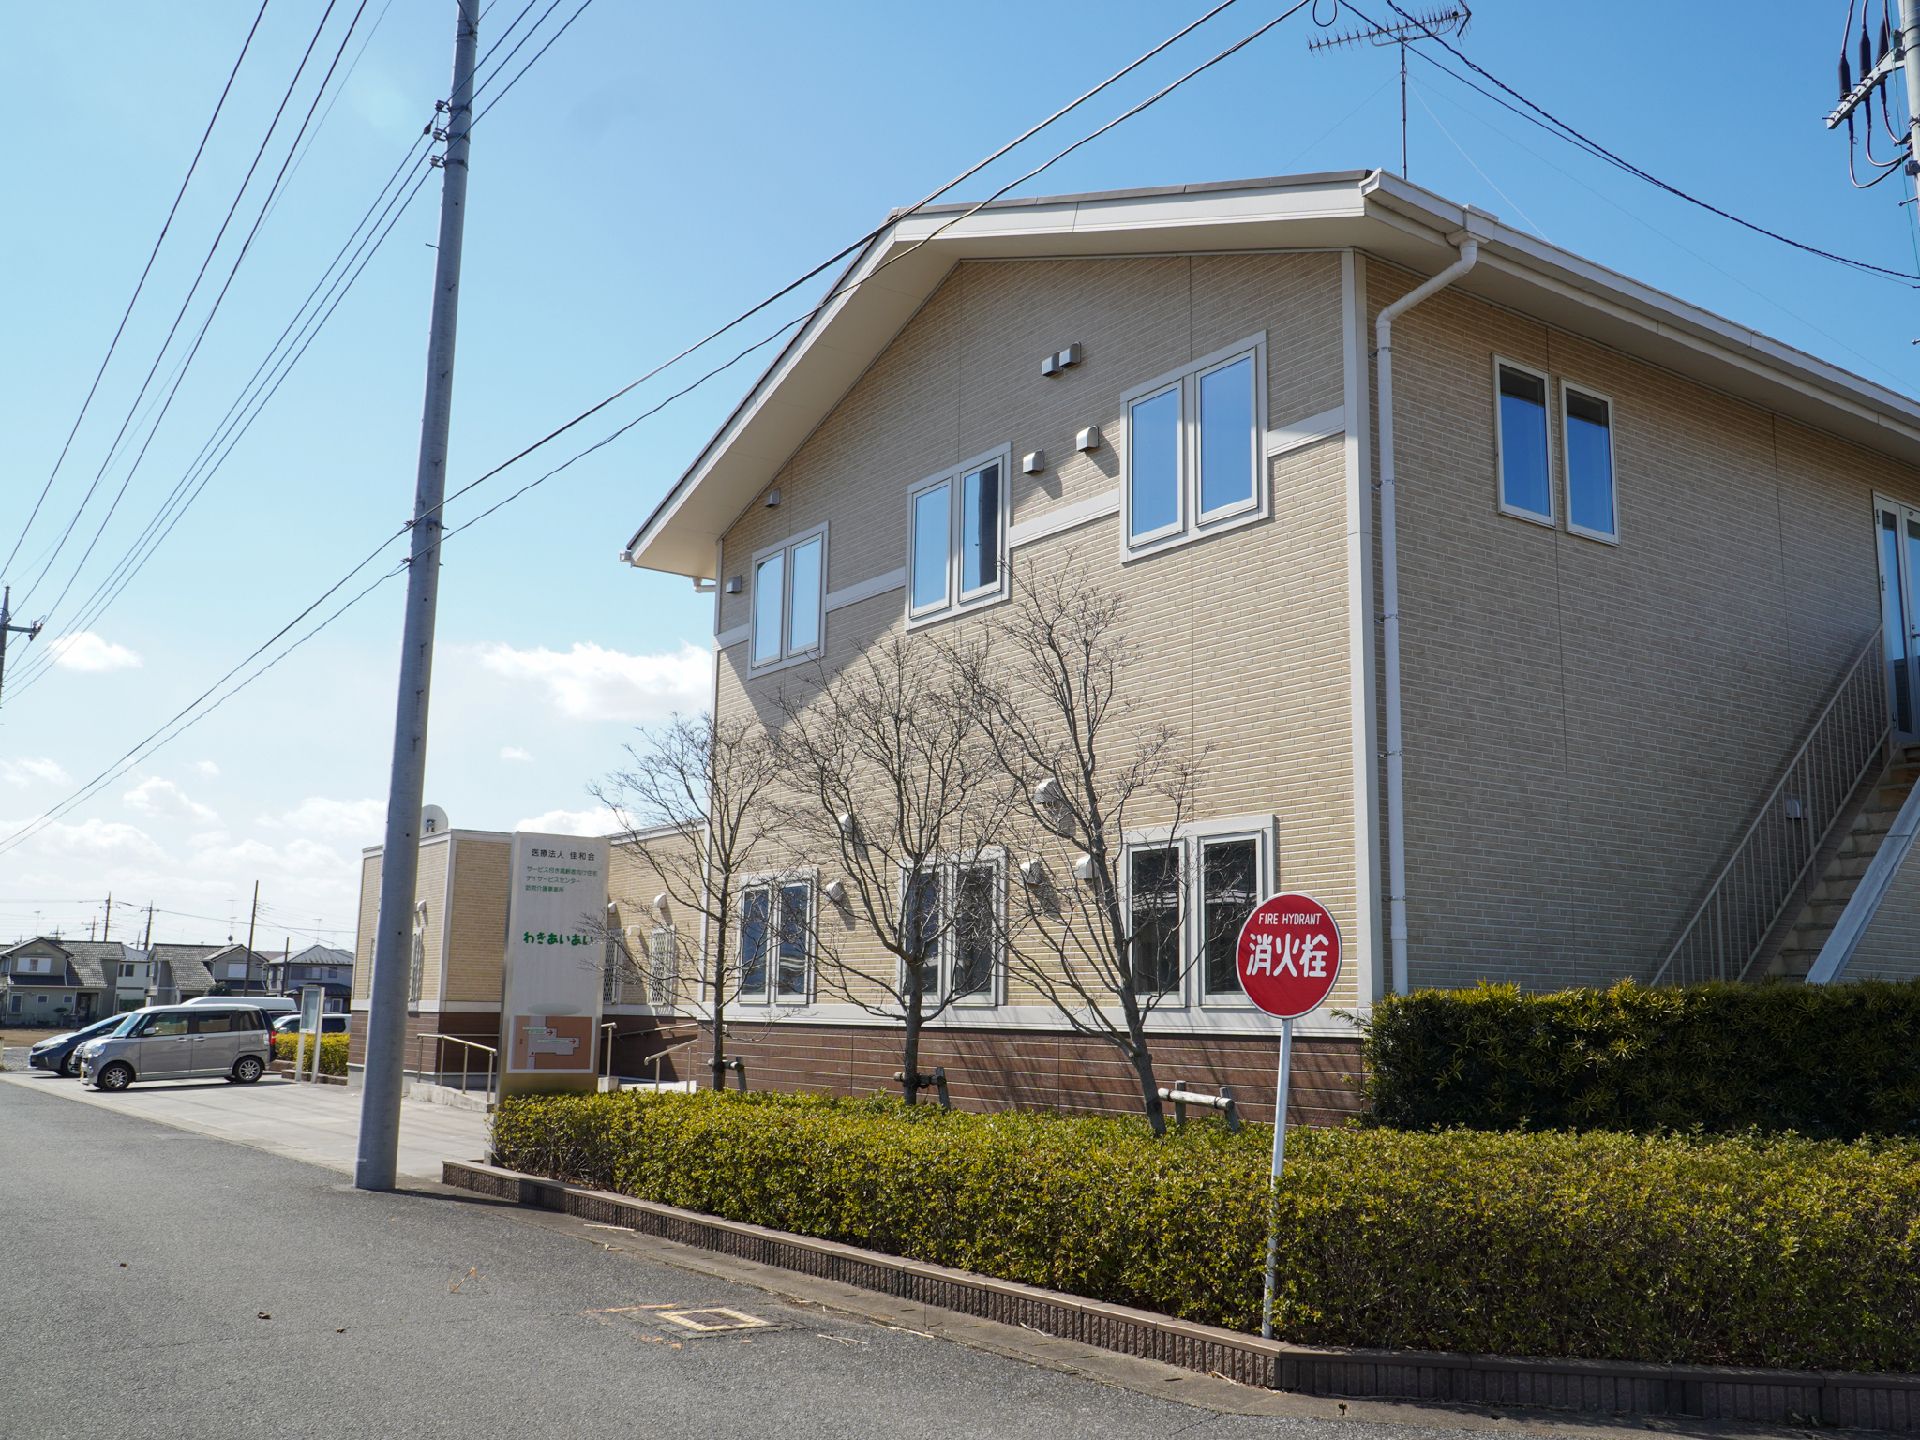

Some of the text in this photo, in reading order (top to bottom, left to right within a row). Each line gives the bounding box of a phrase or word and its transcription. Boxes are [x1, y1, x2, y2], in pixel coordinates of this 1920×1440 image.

[531, 848, 564, 859] 医療法人
[1258, 913, 1322, 925] FIRE HYDRANT
[523, 931, 594, 946] わきあいあい
[1246, 933, 1329, 978] 消火栓
